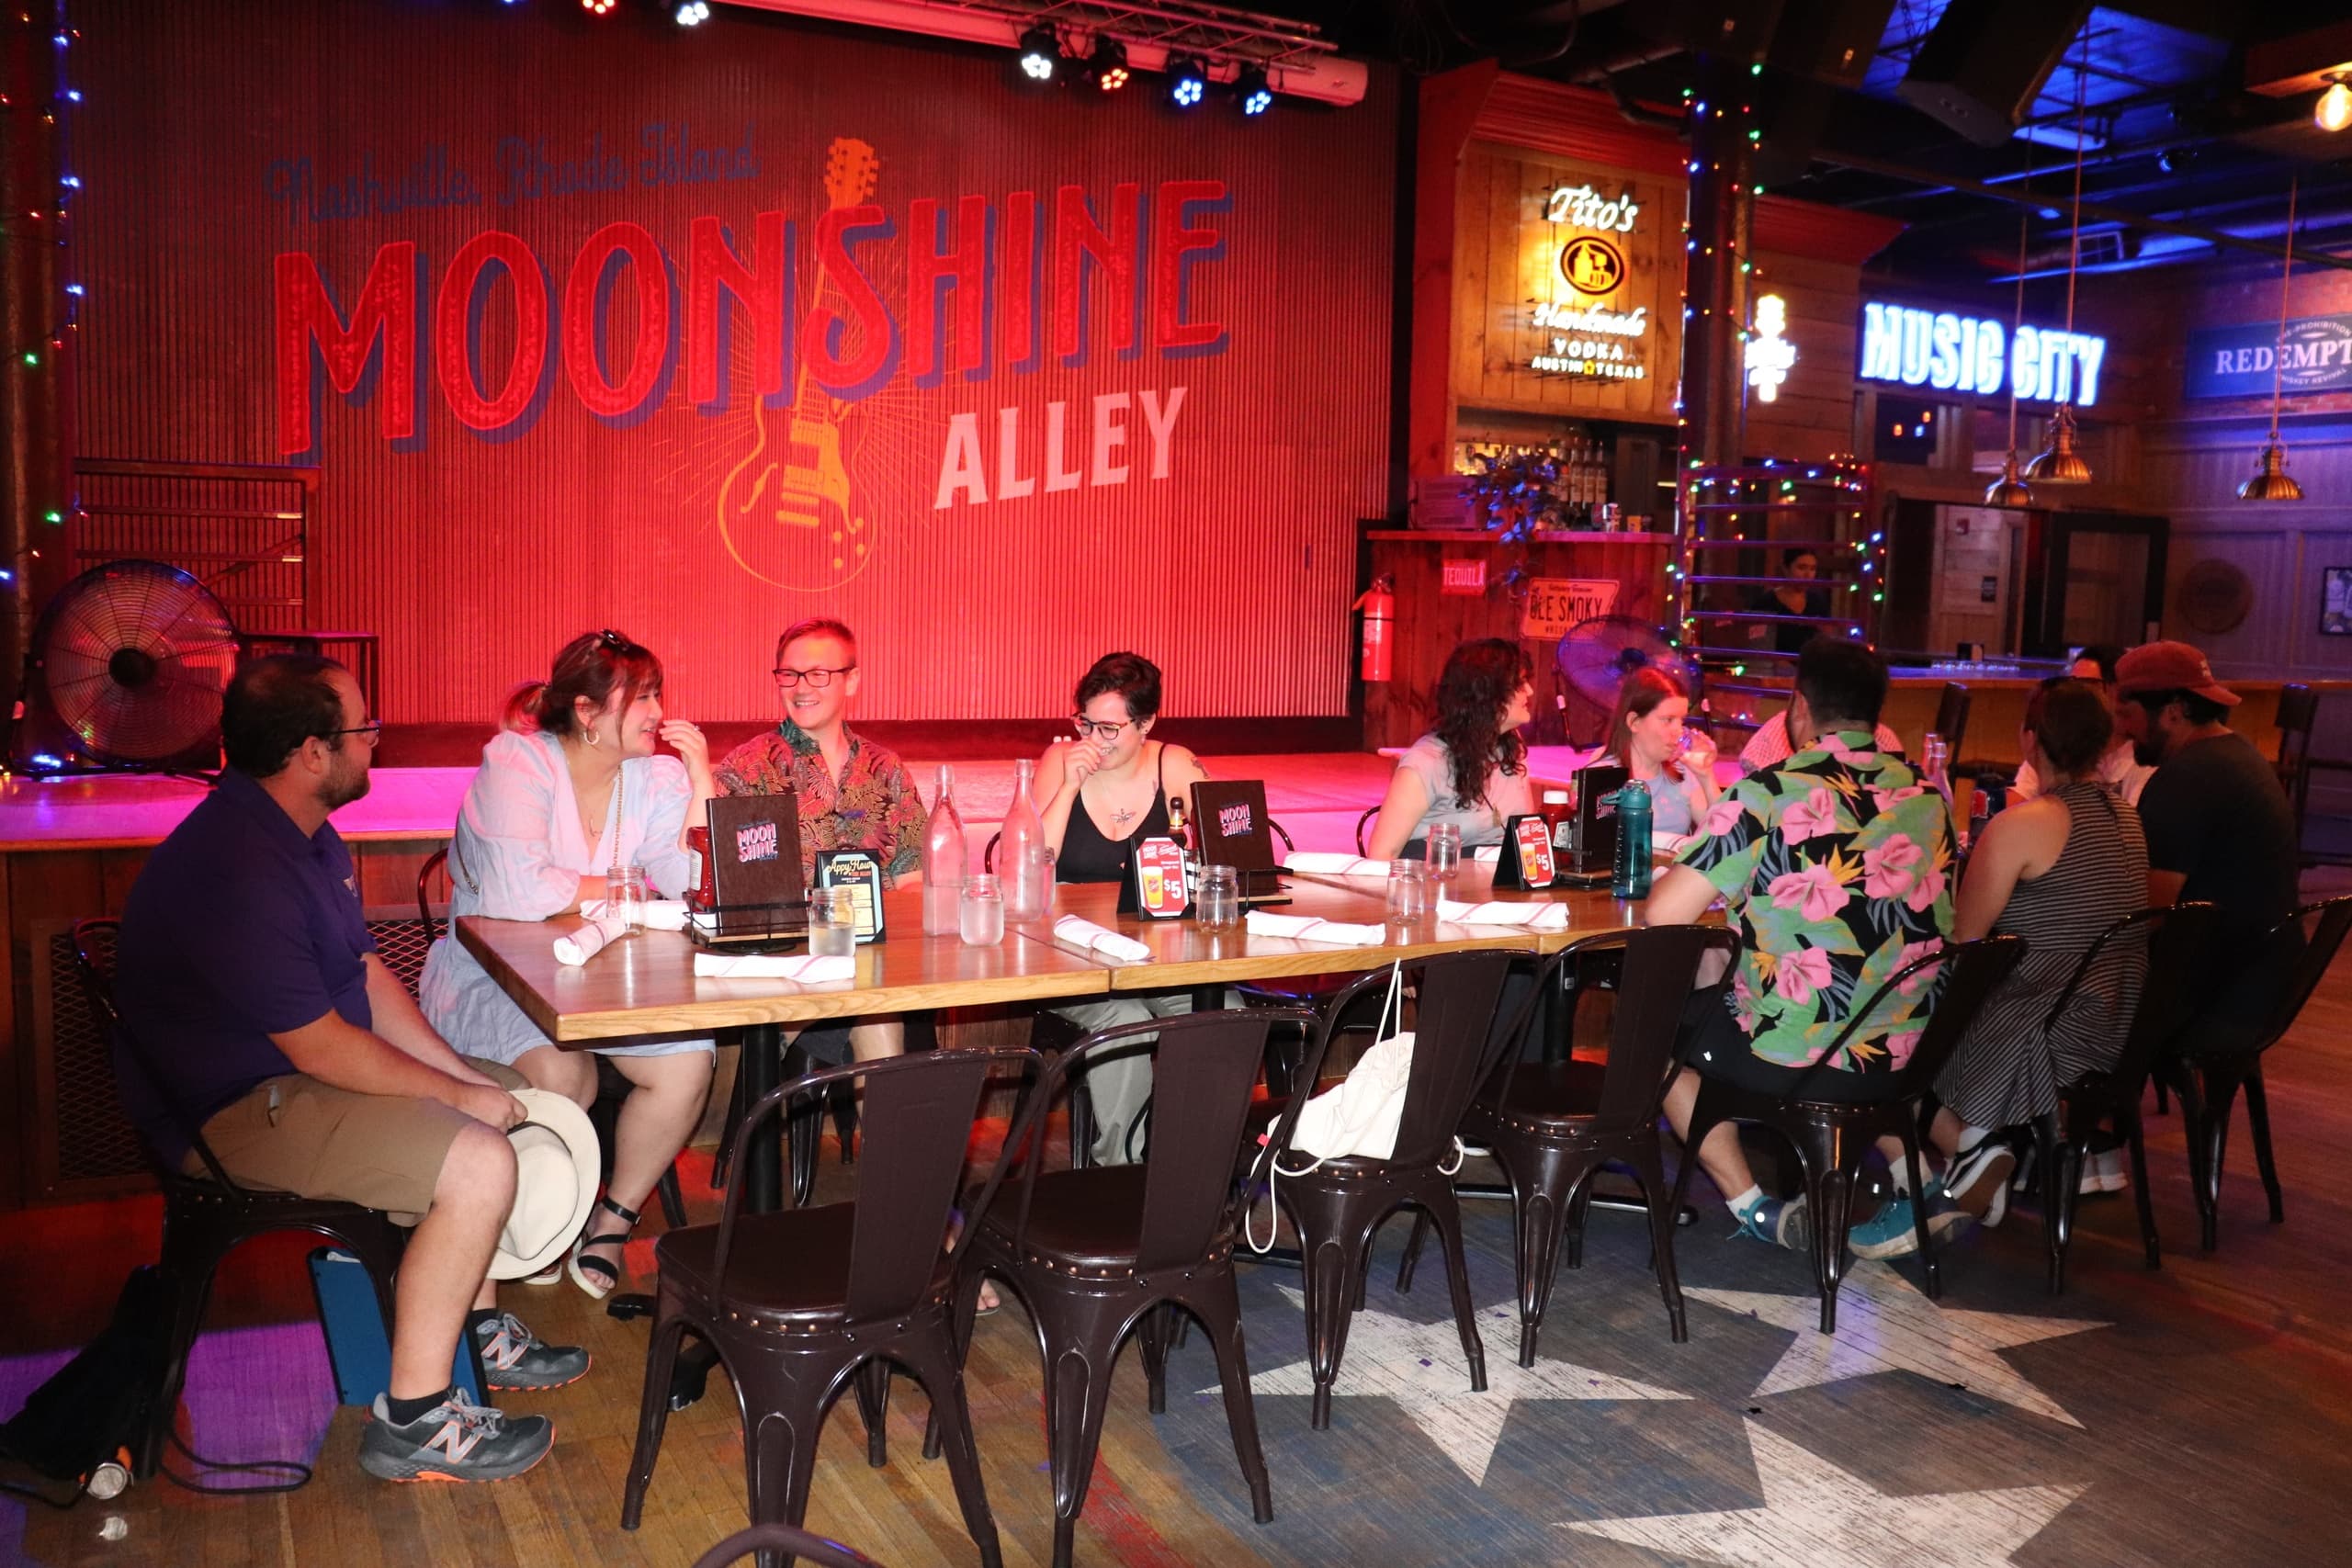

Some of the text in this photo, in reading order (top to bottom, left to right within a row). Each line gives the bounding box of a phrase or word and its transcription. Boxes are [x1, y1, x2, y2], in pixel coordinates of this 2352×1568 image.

[496, 132, 629, 206] Rhode
[639, 119, 762, 187] Island
[1548, 185, 1639, 232] Tito's
[275, 180, 1233, 465] MOONSHINE
[1554, 337, 1623, 360] VODKA
[1860, 302, 2107, 406] MUSIC CITY
[1532, 355, 1645, 379] AUSTIN TEXAS
[933, 386, 1189, 510] ALLEY
[1443, 566, 1485, 586] TEQUILA
[1558, 596, 1602, 622] SMOKY
[1219, 804, 1250, 824] MOON
[736, 823, 776, 847] MOON
[1222, 818, 1252, 837] SHINE
[738, 840, 778, 863] SHINE
[1535, 853, 1550, 871] $5
[1163, 879, 1182, 899] $5
